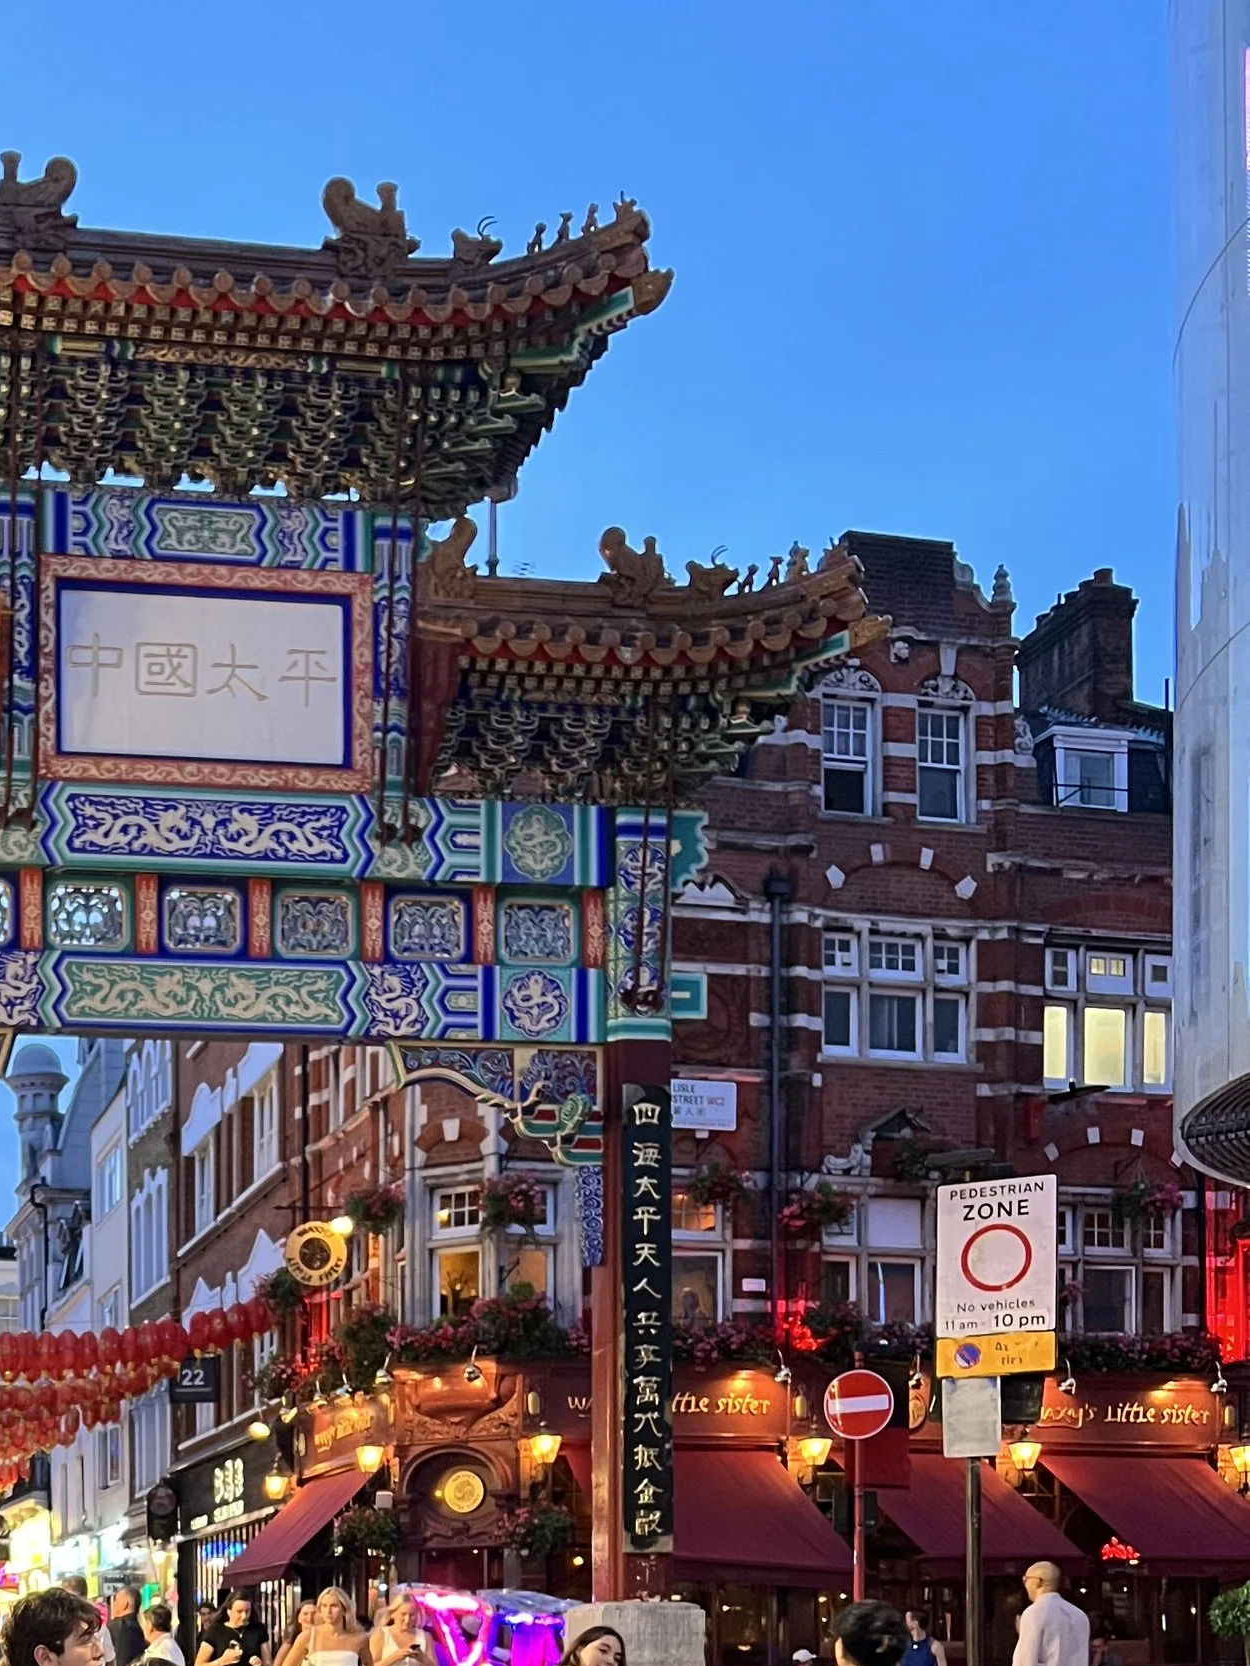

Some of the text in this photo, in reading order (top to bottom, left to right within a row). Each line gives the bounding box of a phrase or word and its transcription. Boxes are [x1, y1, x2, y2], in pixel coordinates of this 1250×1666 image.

[65, 632, 338, 708] 中國太平
[672, 1094, 704, 1105] STREET
[949, 1181, 1045, 1201] PEDESTRIAN
[963, 1199, 1030, 1221] ZONE
[956, 1298, 1036, 1313] No vehicles
[994, 1313, 1014, 1327] 10
[1019, 1314, 1046, 1329] pm
[181, 1369, 206, 1386] 22
[671, 1392, 771, 1415] ttle sister
[1160, 1403, 1210, 1425] sister
